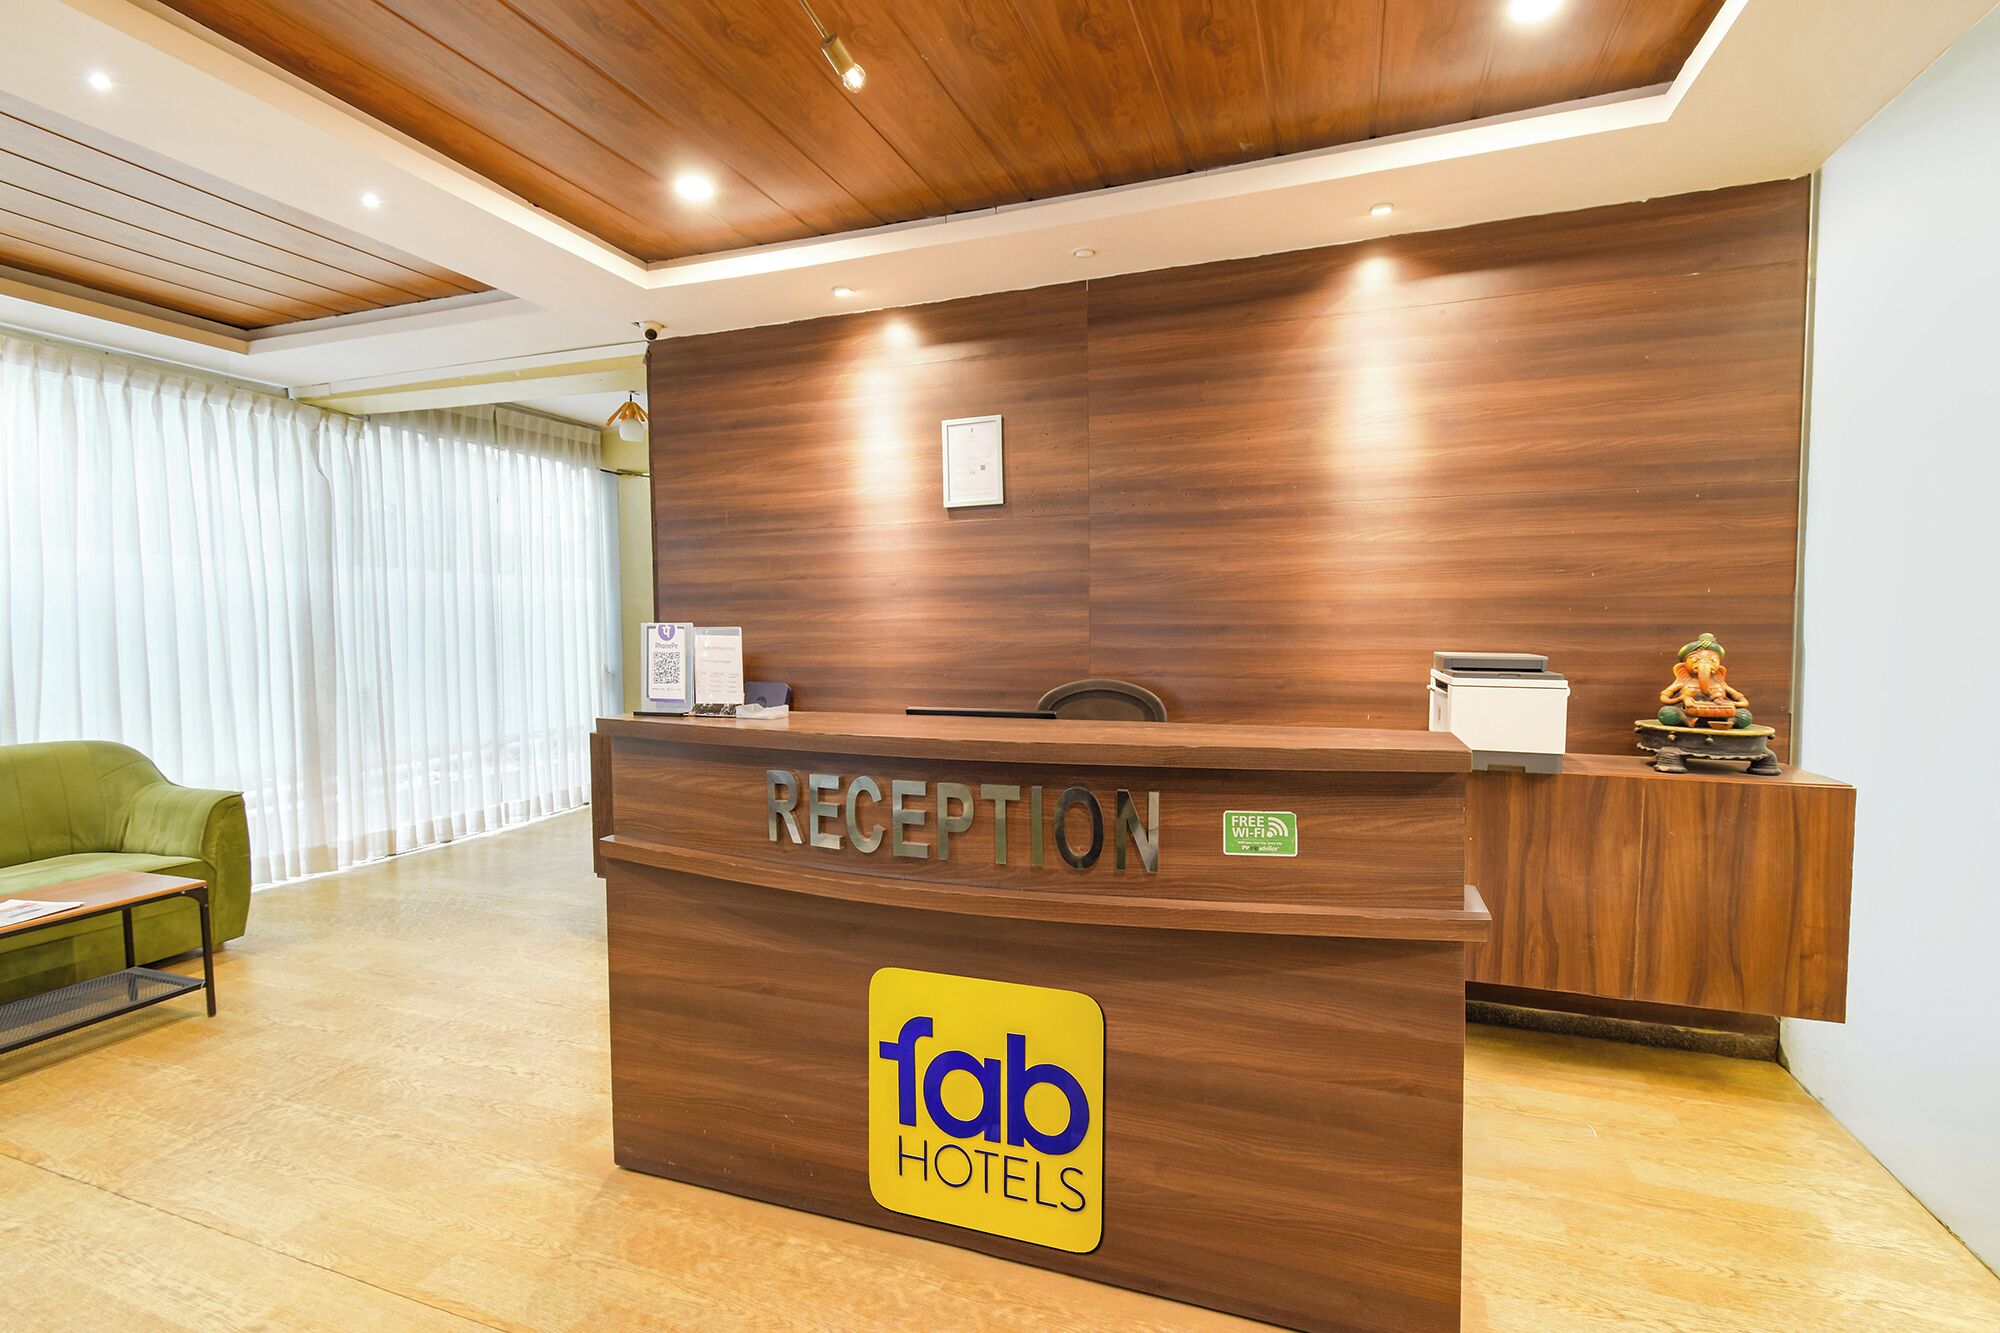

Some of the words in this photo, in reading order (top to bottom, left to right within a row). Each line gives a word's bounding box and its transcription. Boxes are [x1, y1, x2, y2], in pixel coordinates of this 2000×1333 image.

[765, 769, 1160, 874] RECEPTION
[1231, 815, 1265, 827] FREE
[1231, 827, 1265, 838] WI-FI
[879, 1016, 1090, 1156] fab
[898, 1134, 1087, 1213] HOTELS
